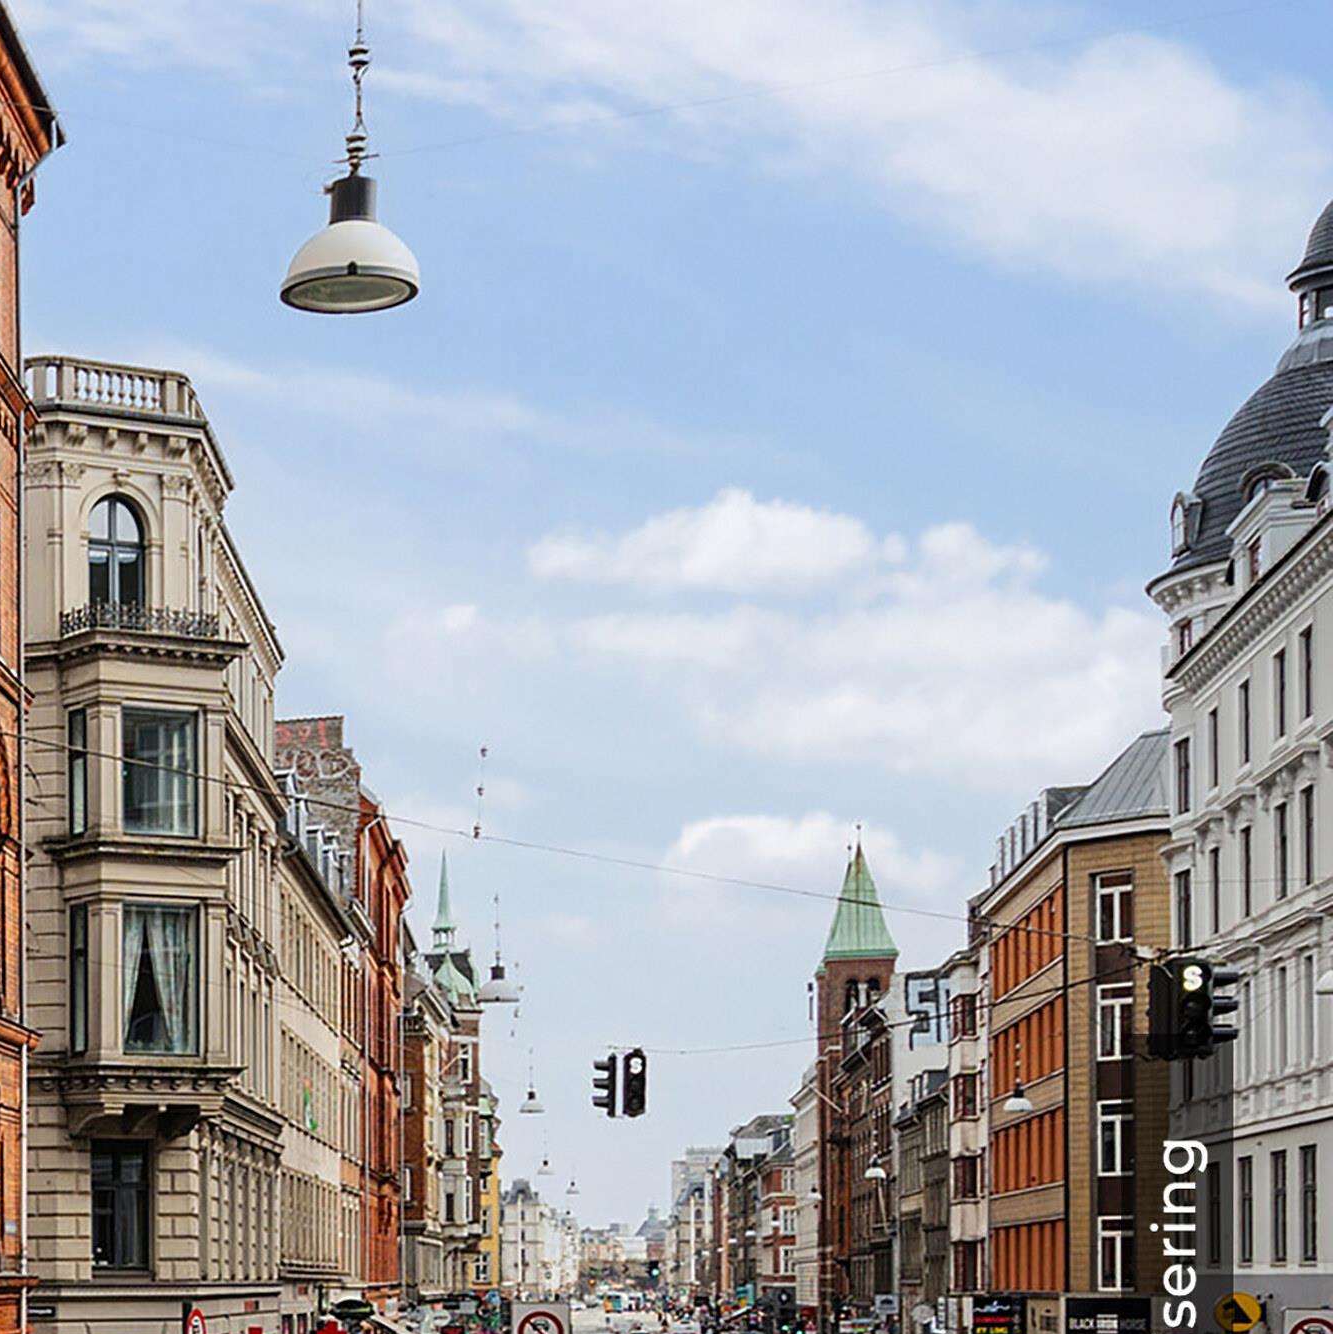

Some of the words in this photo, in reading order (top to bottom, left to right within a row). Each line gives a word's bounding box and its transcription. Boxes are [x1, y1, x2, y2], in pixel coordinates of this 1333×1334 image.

[1069, 1318, 1094, 1330] BLACK
[1096, 1319, 1118, 1330] IRON
[1120, 1318, 1146, 1330] HORSE
